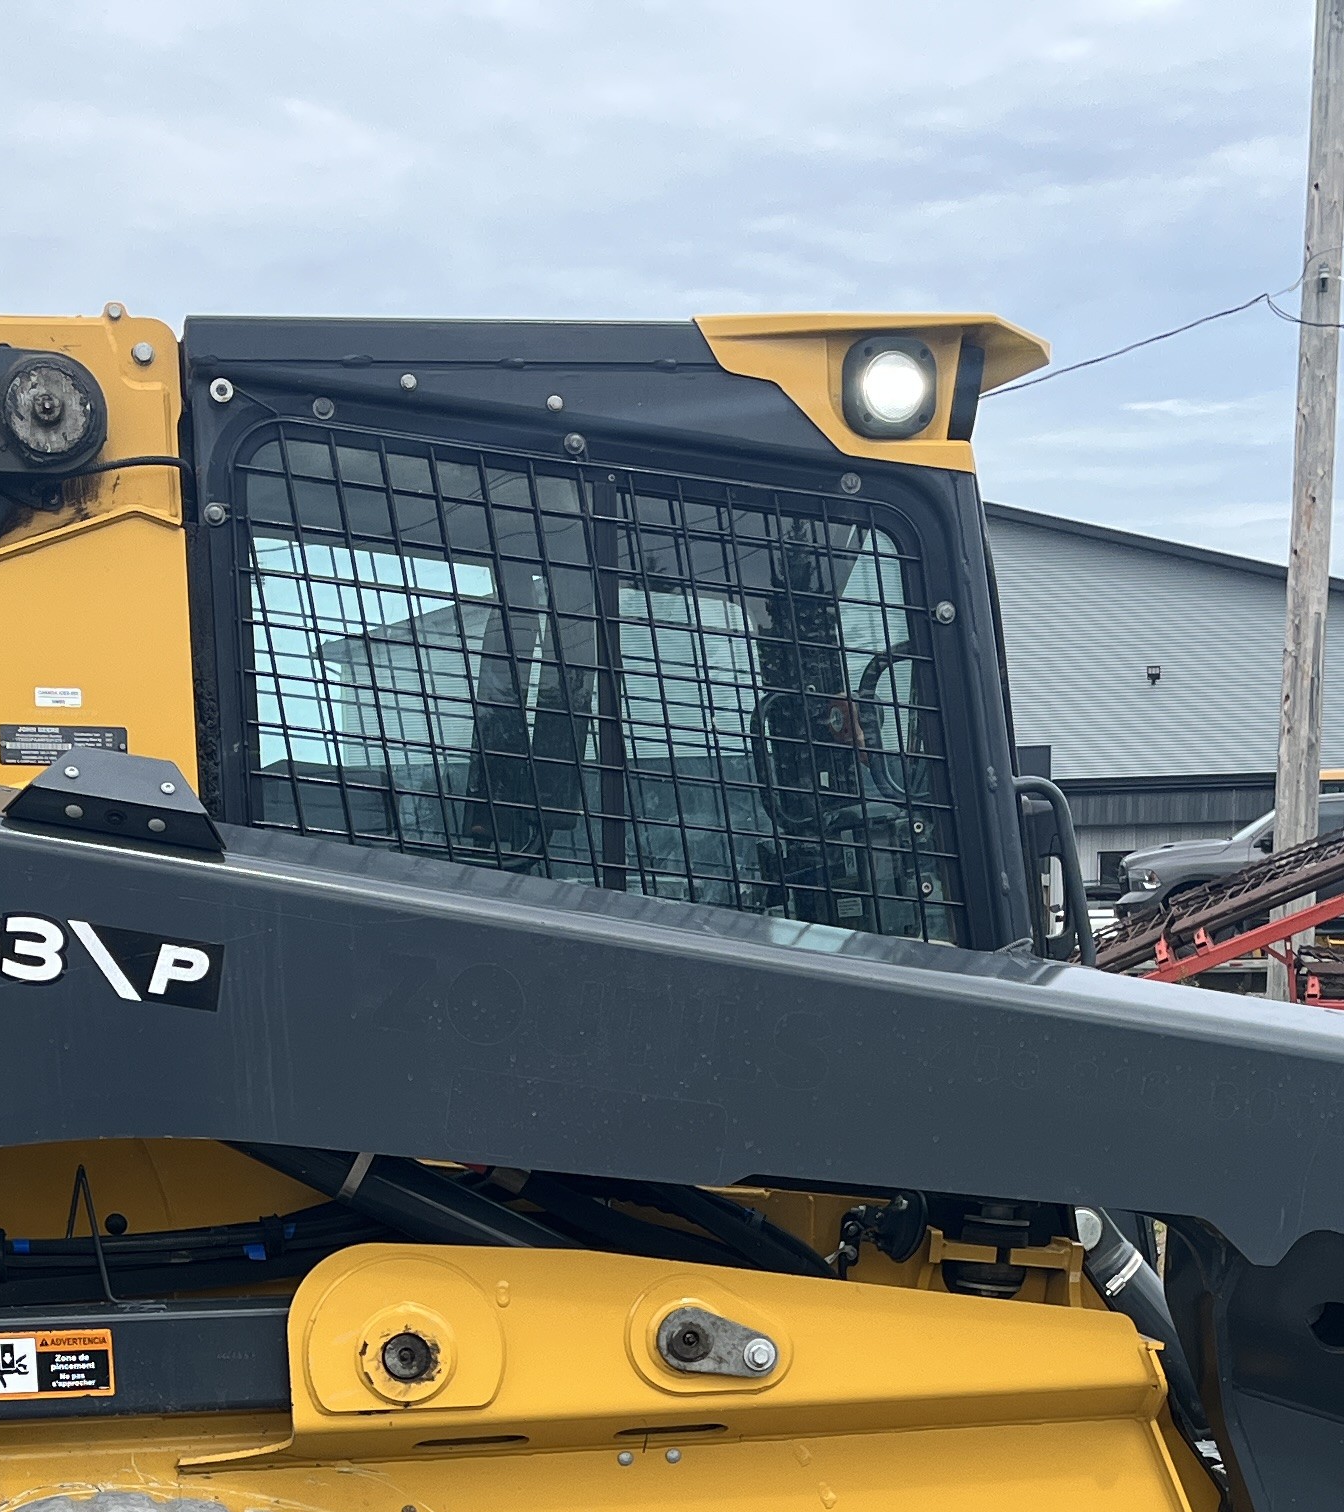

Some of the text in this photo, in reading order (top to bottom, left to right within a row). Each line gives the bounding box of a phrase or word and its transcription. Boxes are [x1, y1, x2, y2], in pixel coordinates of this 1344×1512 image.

[50, 1336, 108, 1346] ADVERTENCIA
[54, 1353, 90, 1362] Zone de
